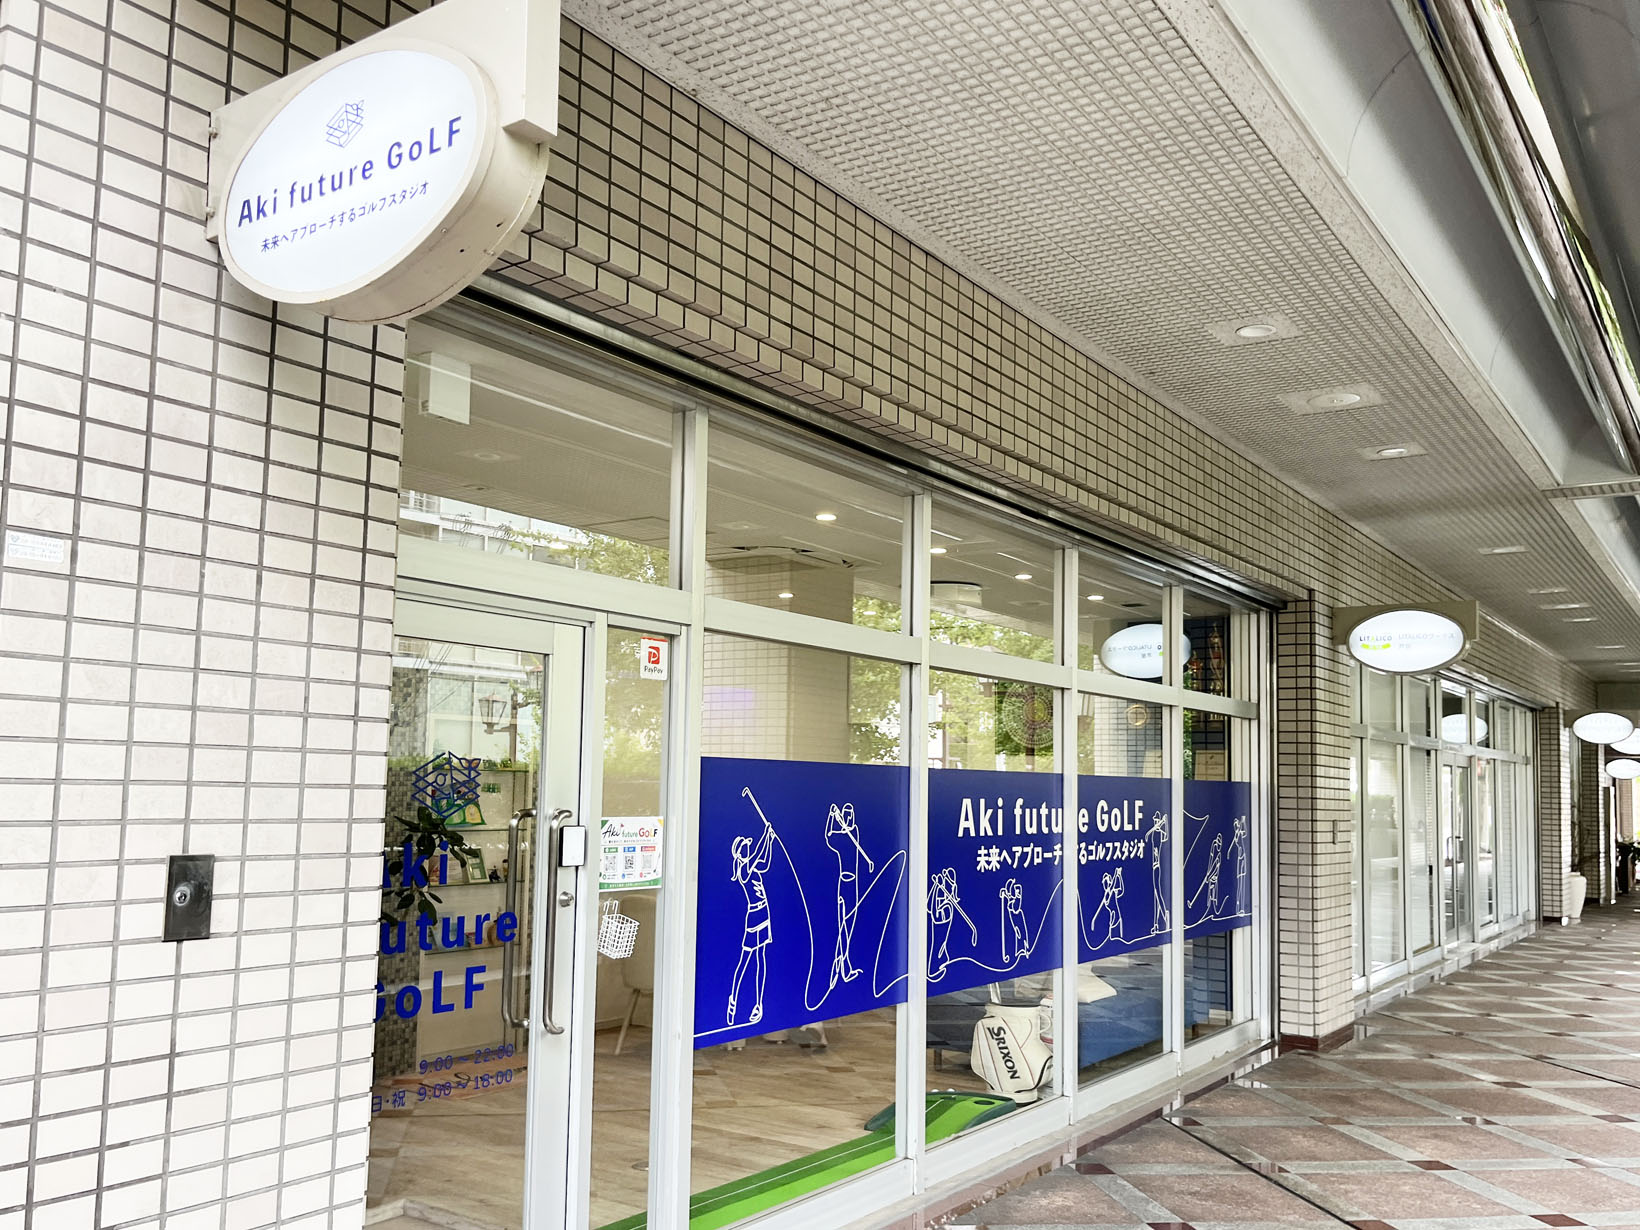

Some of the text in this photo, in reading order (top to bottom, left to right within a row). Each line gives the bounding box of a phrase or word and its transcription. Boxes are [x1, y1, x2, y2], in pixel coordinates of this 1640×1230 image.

[238, 116, 462, 227] Aki future GoLF
[260, 181, 430, 253] 未来へアプローチするゴルフスタジオ
[644, 665, 663, 674] PayPay
[602, 824, 620, 839] Aki
[638, 827, 658, 838] GoLF
[957, 798, 1143, 837] Aki futue GoLF
[976, 839, 1145, 872] 未来へアプローチるゴルフスタジオ
[380, 911, 517, 954] uture
[987, 1026, 1020, 1080] SRIXON
